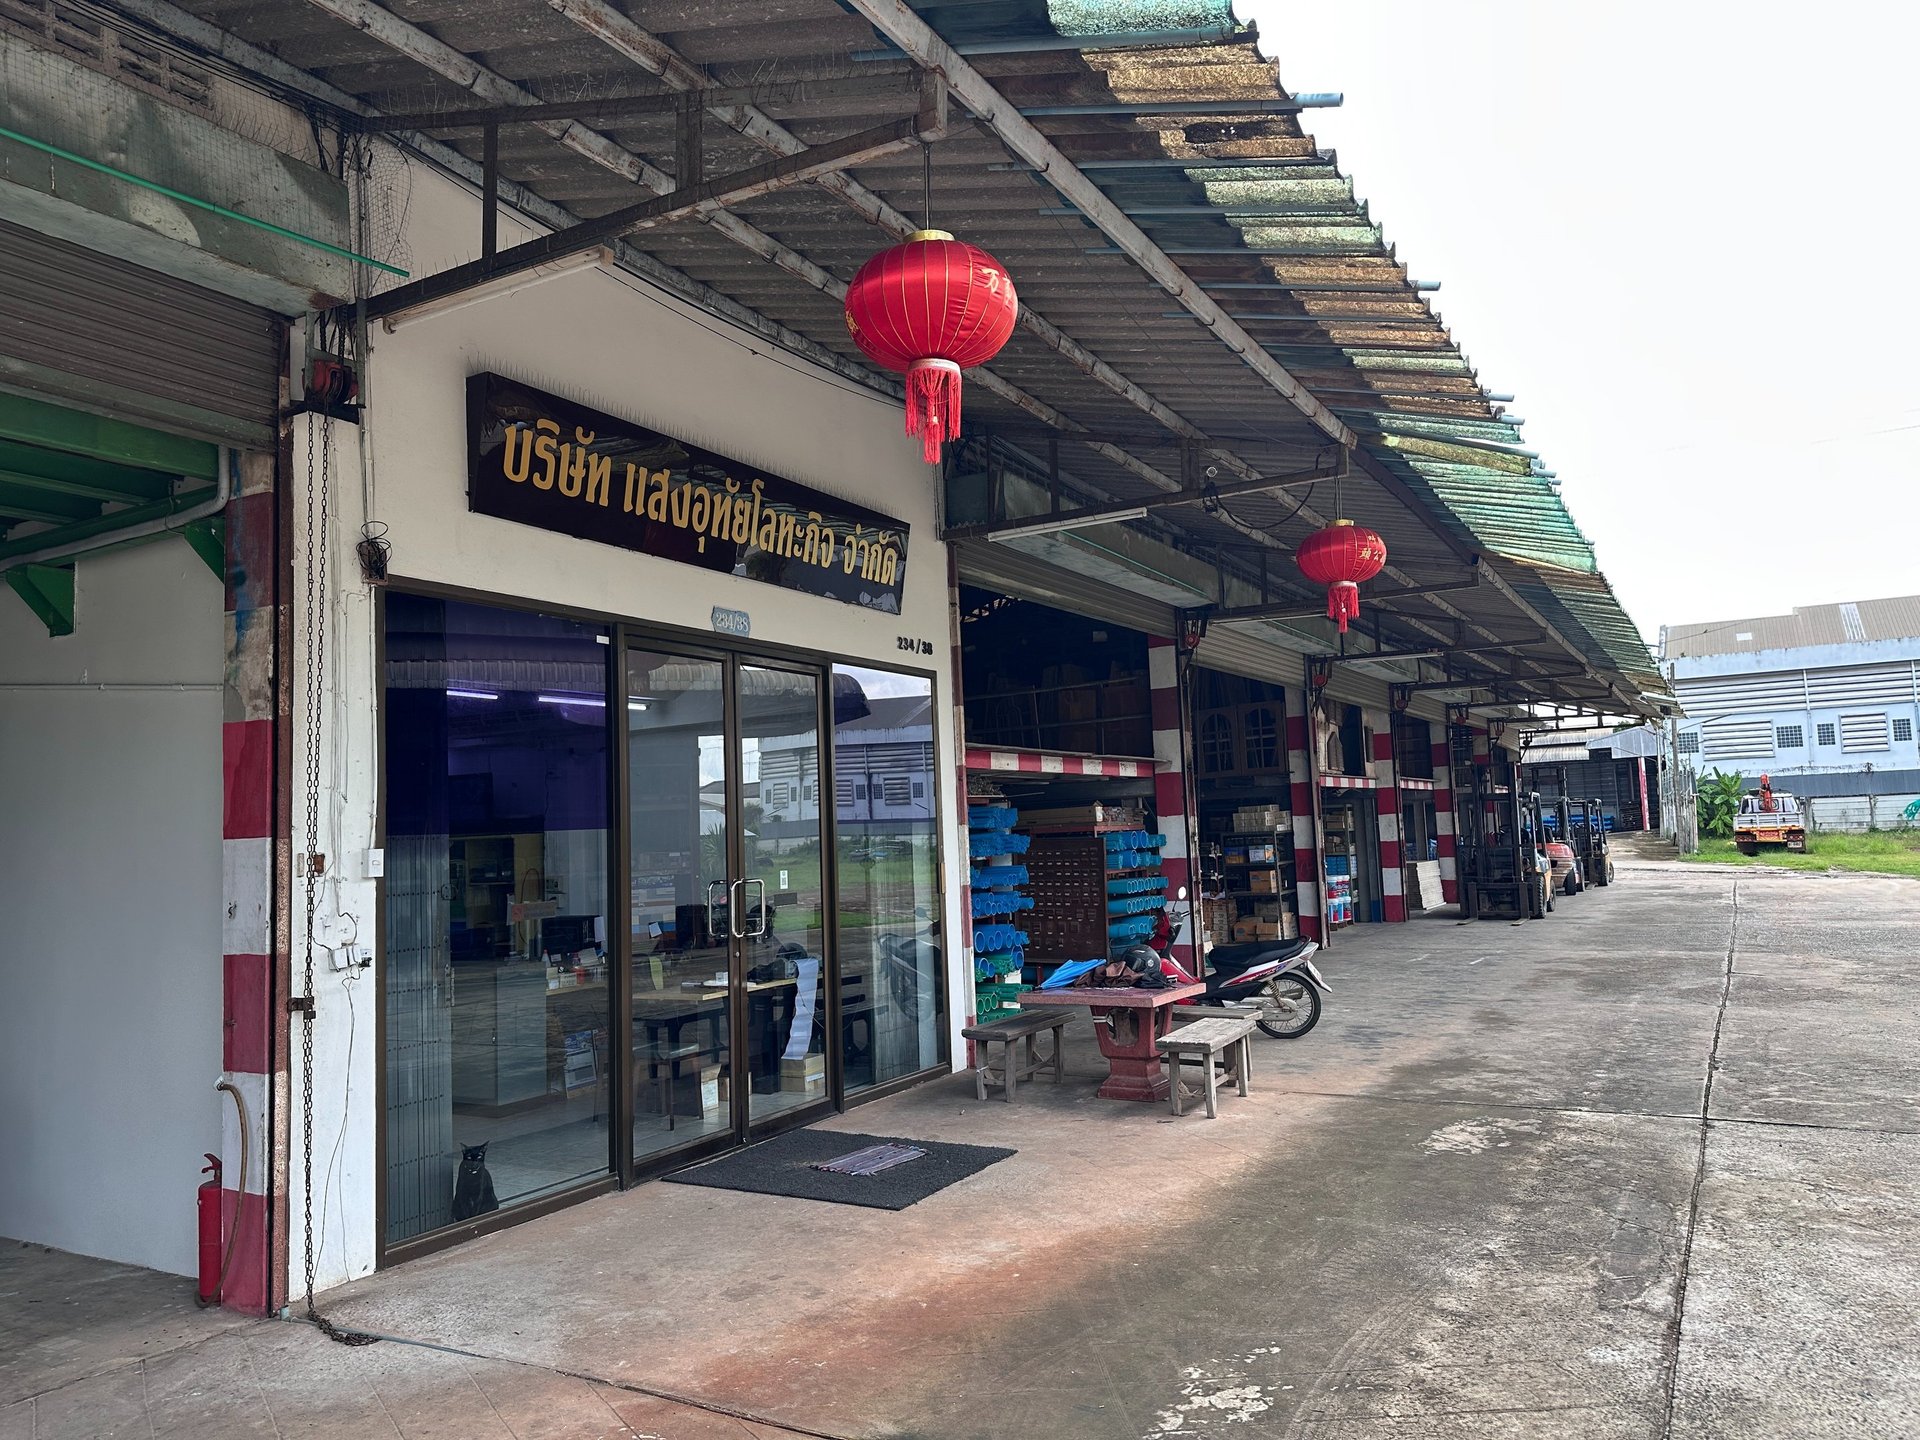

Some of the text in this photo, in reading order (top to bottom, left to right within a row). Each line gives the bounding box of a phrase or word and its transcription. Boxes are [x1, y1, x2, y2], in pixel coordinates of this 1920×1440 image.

[503, 418, 898, 587] บริษัท แสงอุทัยโลหะกิจ จำกัด
[716, 612, 749, 632] 234/38
[896, 636, 933, 655] 234/38
